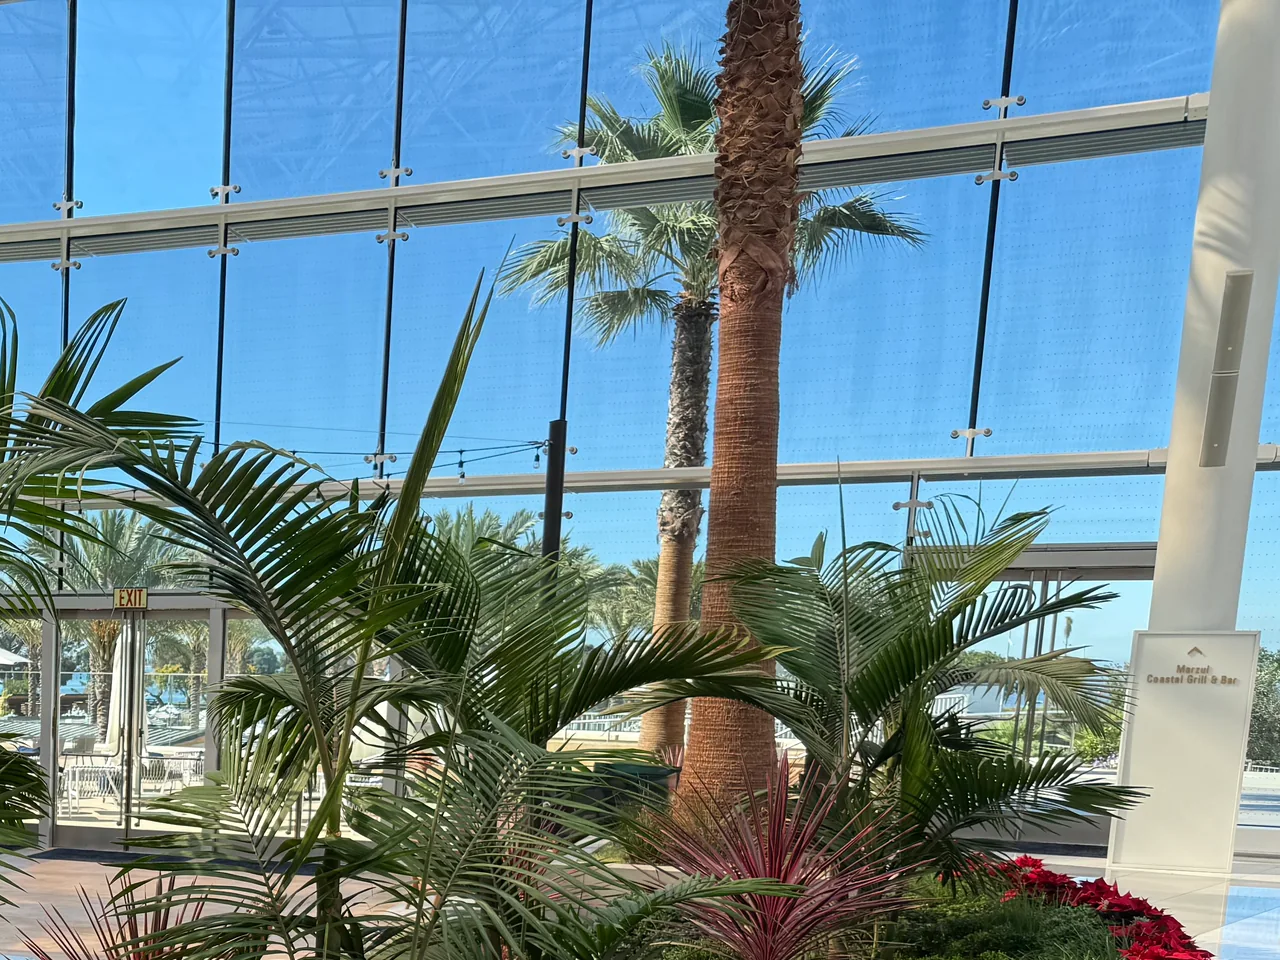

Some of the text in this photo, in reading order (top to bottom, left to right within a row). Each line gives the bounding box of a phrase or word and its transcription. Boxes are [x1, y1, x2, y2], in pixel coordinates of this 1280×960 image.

[119, 589, 143, 607] EXIT
[1176, 664, 1210, 674] Marzul
[1146, 674, 1238, 685] Coastal Grill & Bar
